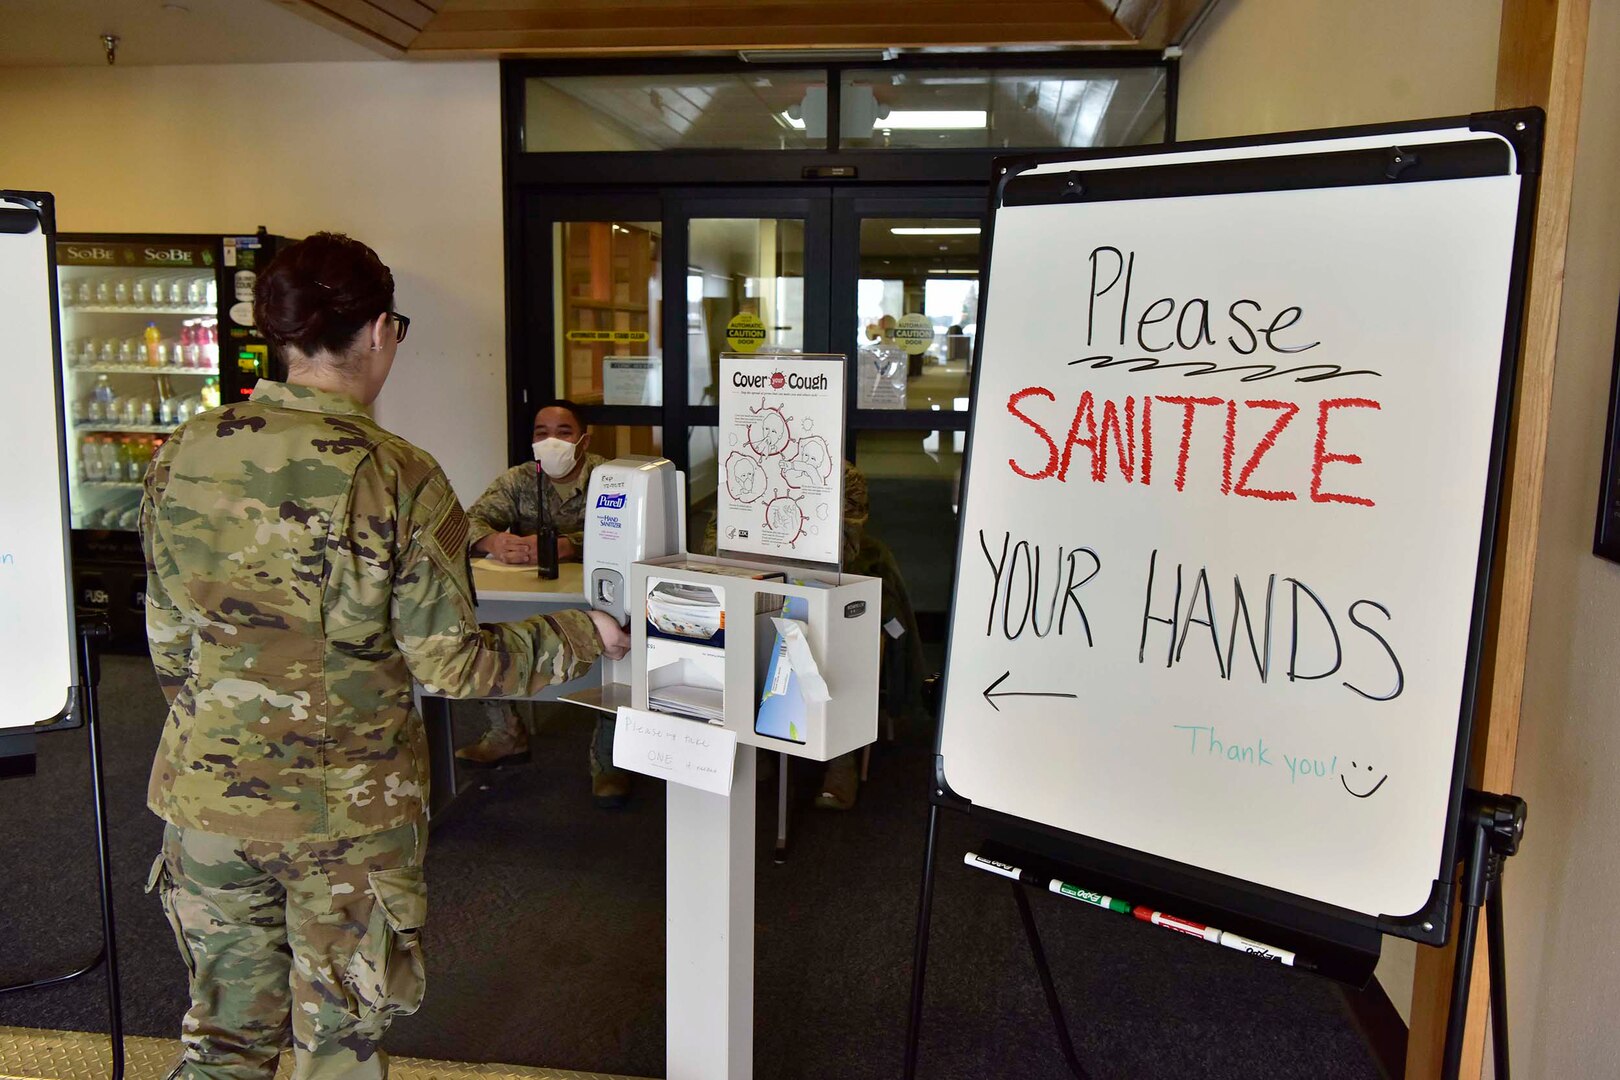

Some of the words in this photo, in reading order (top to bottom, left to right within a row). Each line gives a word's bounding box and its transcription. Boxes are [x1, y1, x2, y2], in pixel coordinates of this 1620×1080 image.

[1088, 245, 1321, 354] Please
[728, 330, 765, 338] CAUTION
[896, 330, 933, 338] CAUTION
[732, 371, 768, 389] Cover
[788, 372, 828, 390] Cough
[1006, 386, 1381, 507] SANITIZE
[599, 495, 624, 508] Purell
[600, 520, 622, 529] SANITIZER
[604, 514, 619, 523] HAND
[979, 529, 1101, 648] YOUR
[1138, 548, 1405, 702] HANDS
[647, 749, 673, 765] ONE
[1173, 724, 1274, 767] Thank
[1282, 754, 1338, 785] you!
[1077, 888, 1102, 903] EXPO
